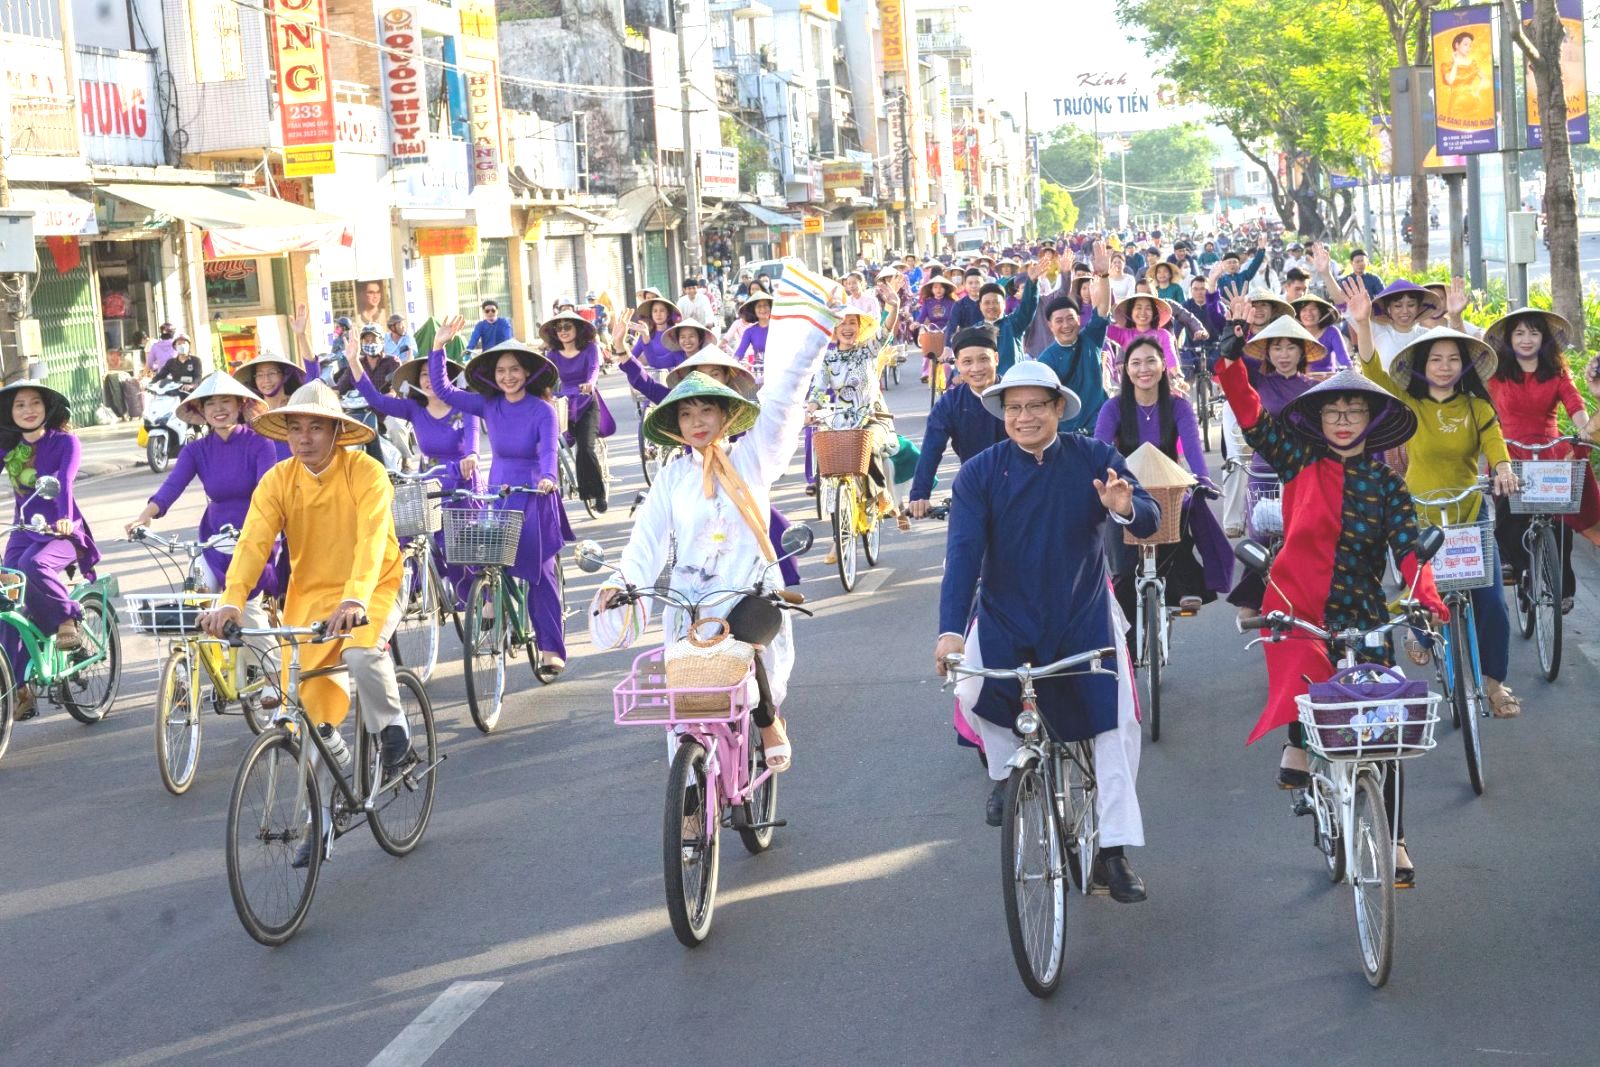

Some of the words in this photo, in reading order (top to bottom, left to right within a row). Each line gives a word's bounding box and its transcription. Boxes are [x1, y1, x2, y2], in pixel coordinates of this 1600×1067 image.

[1076, 72, 1127, 87] Kính
[289, 104, 322, 119] 233
[1053, 92, 1112, 116] TRƯỜNG
